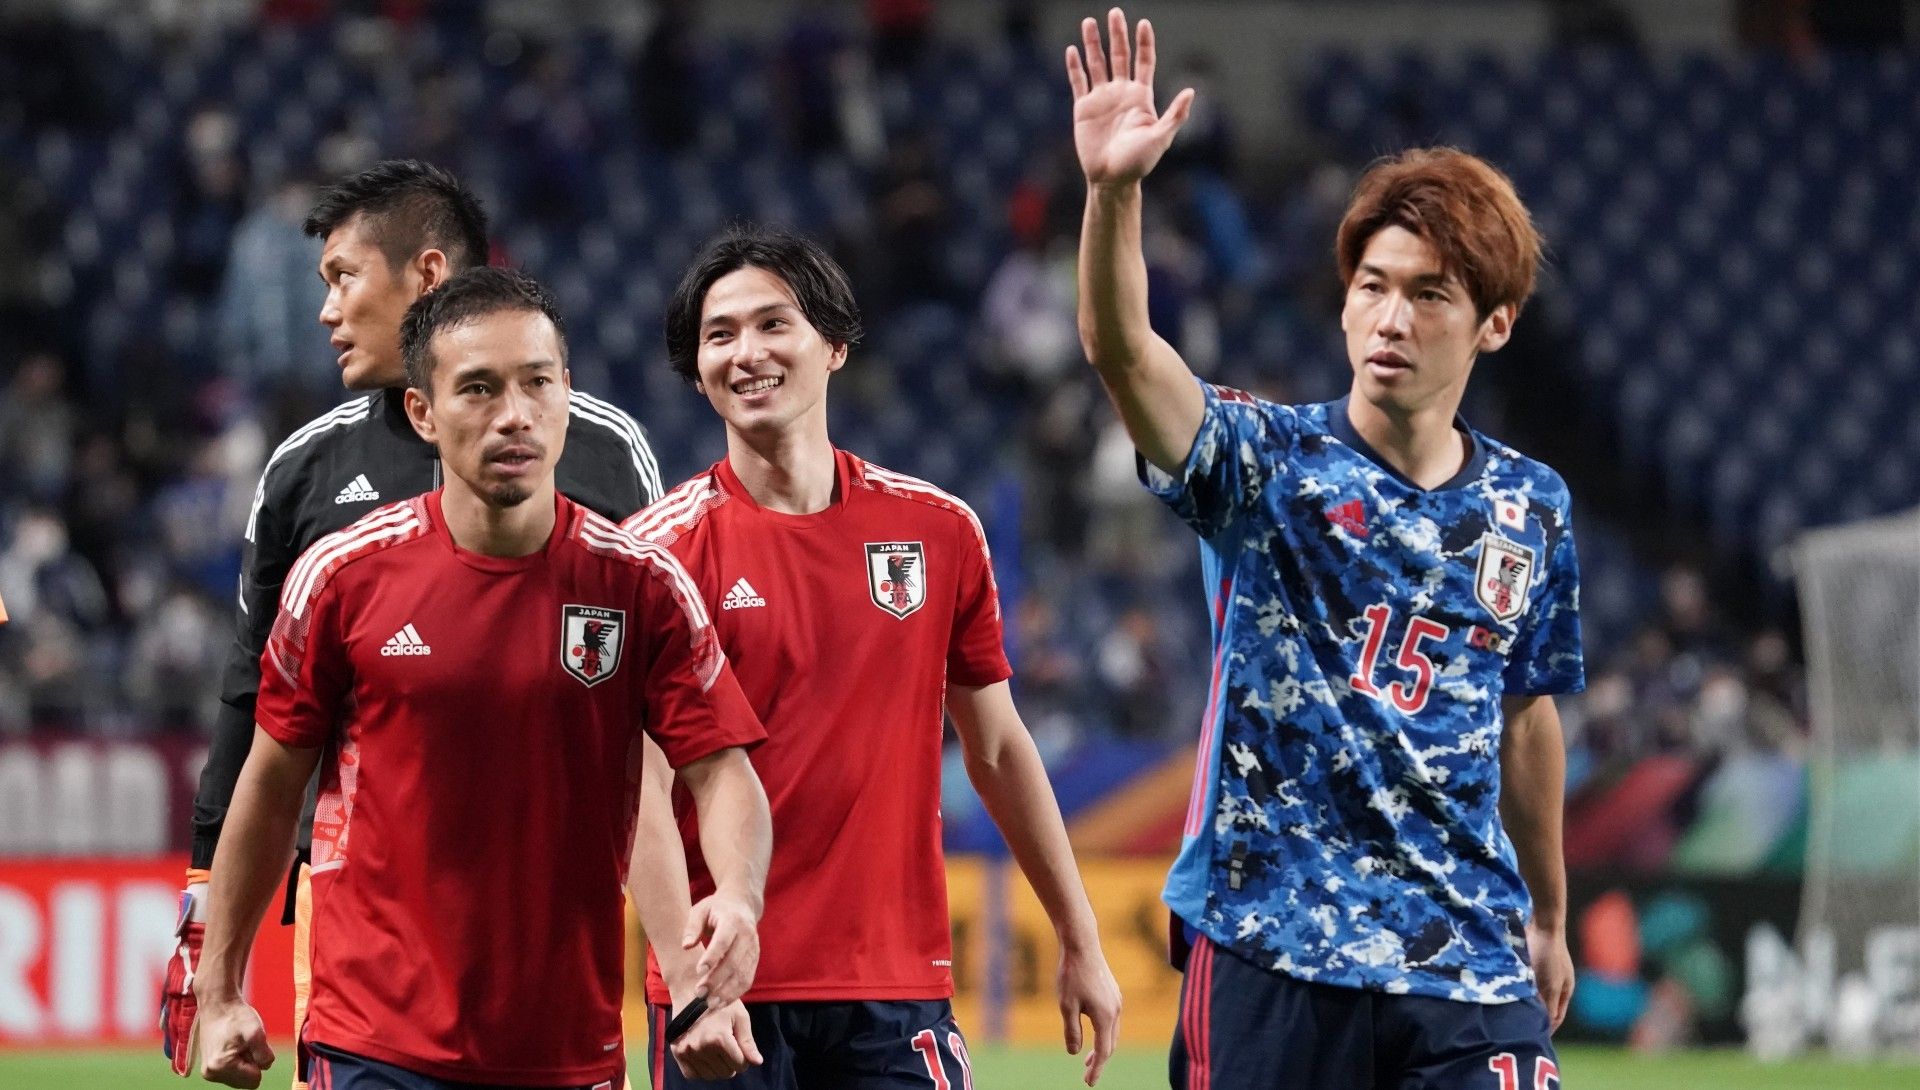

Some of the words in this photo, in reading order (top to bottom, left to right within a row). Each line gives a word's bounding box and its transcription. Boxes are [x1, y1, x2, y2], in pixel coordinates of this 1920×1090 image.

[335, 490, 379, 504] adidas
[722, 596, 766, 610] adidas
[579, 609, 610, 618] JAPAN
[380, 642, 431, 656] adidas
[1350, 602, 1449, 716] 15
